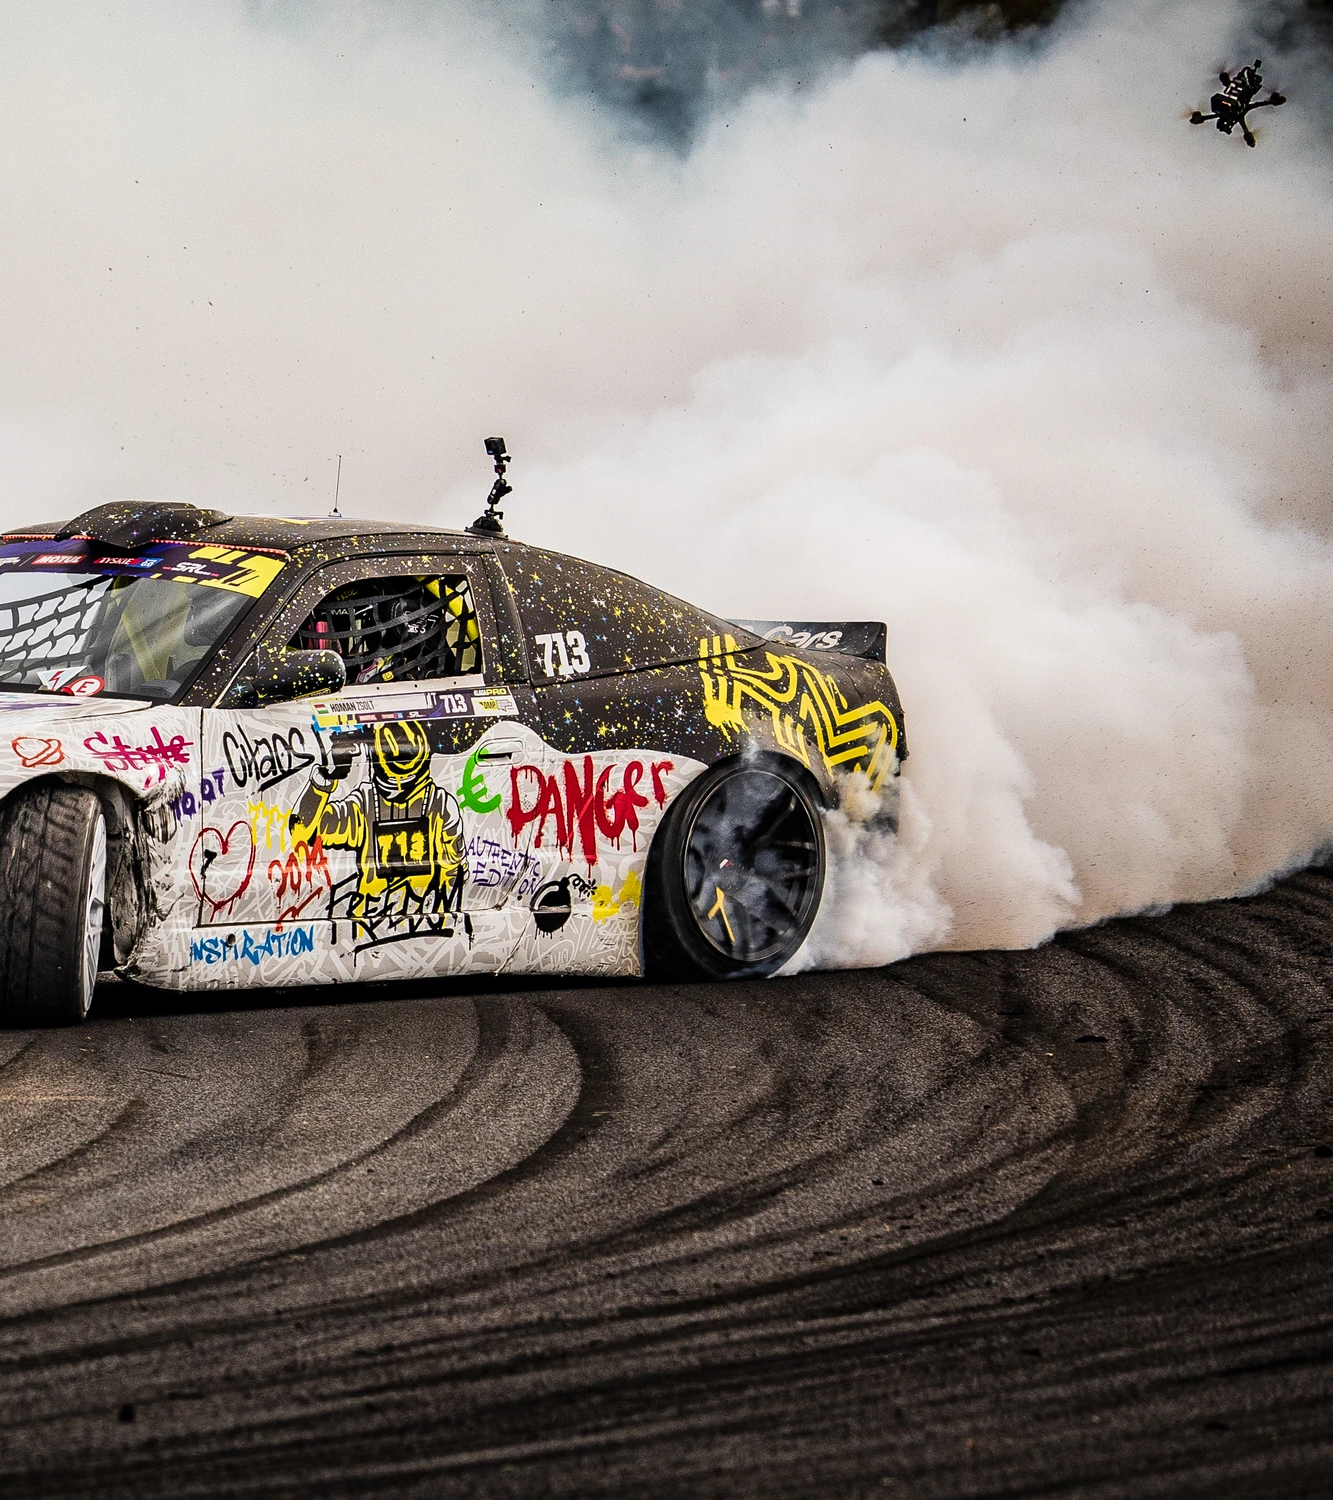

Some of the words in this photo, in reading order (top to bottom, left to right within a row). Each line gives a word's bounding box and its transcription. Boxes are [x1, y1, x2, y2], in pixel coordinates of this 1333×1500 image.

[34, 555, 83, 564] MOTUL
[171, 562, 207, 575] SRL
[535, 630, 591, 677] 713
[486, 688, 507, 696] PRO
[330, 702, 357, 713] HOMAN
[356, 701, 376, 711] ZSOLT
[439, 694, 468, 714] 713
[378, 830, 427, 867] 713
